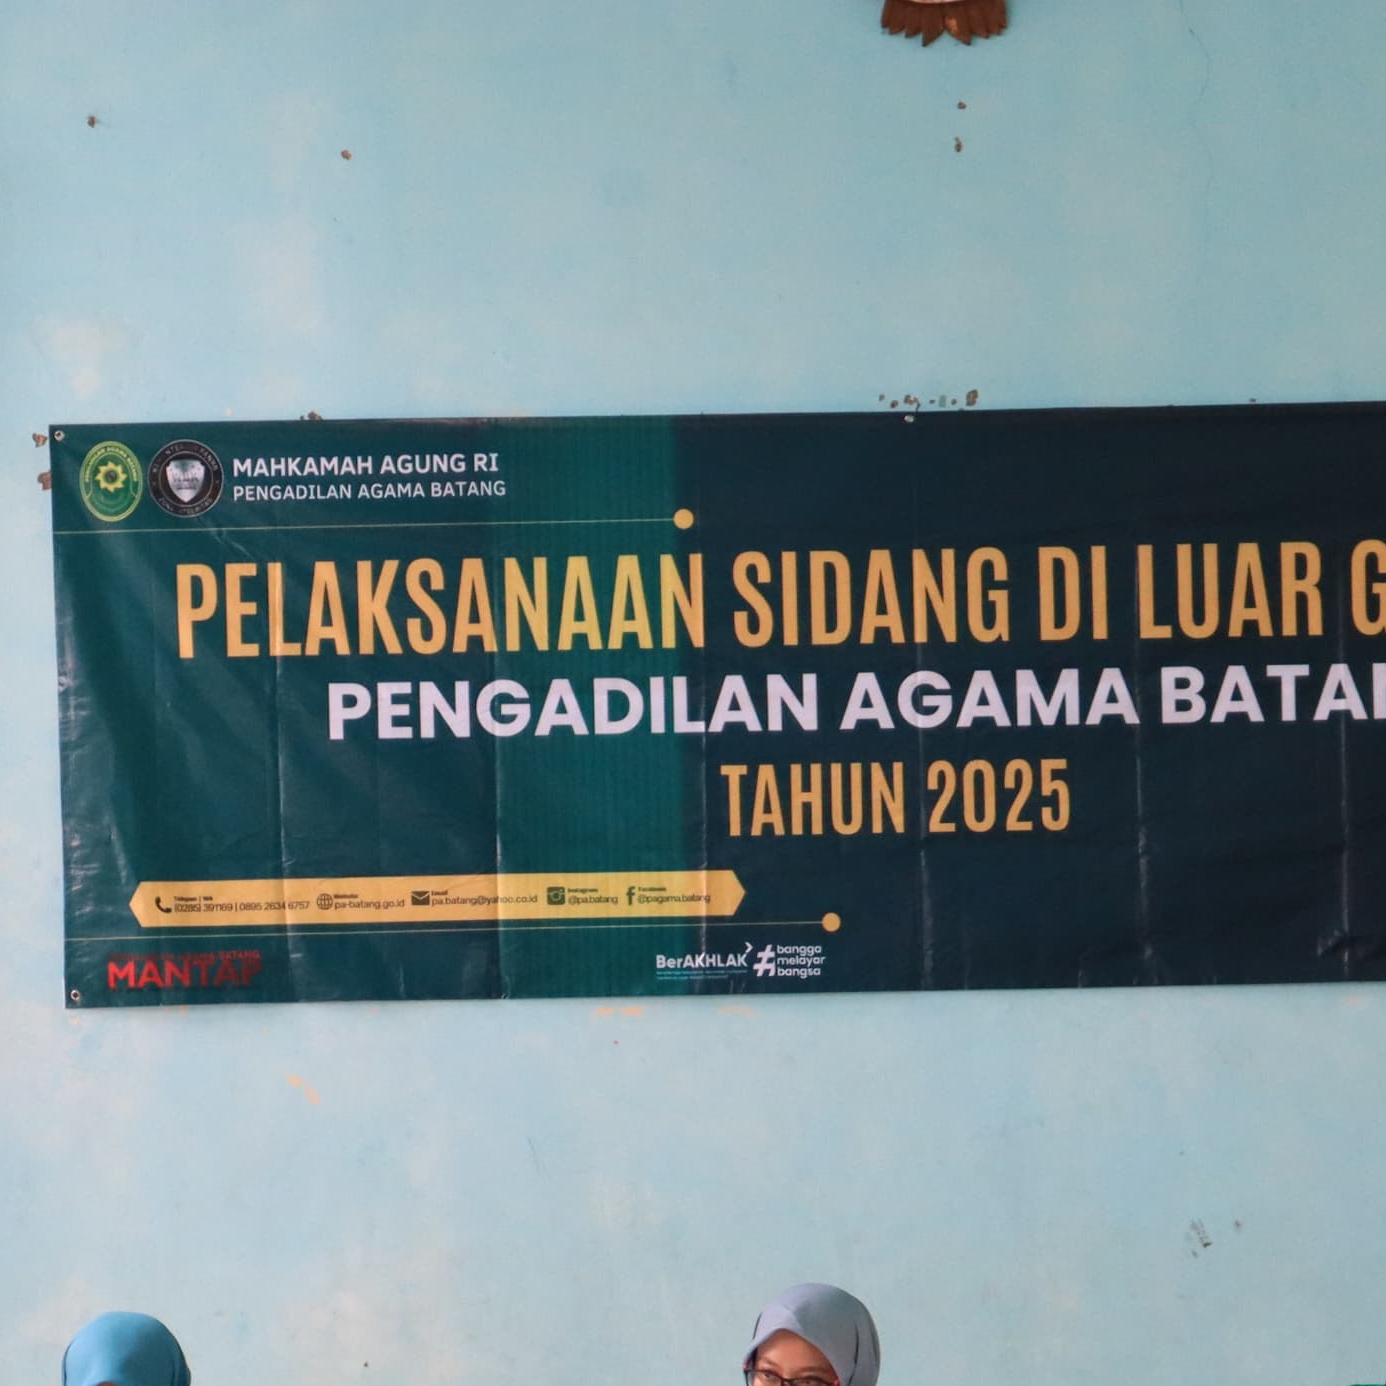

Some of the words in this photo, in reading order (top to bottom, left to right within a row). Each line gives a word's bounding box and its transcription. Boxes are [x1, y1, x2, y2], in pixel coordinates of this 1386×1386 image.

[233, 455, 373, 477] MAHKAMAH
[379, 453, 467, 475] AGUNG
[473, 453, 500, 472] RI
[233, 484, 353, 501] PENGADILAN
[357, 482, 425, 499] AGAMA
[430, 480, 507, 497] BATANG
[176, 553, 705, 659] PELAKSANAAN
[732, 547, 1009, 647] SIDANG
[1038, 546, 1108, 641] DI
[1137, 542, 1323, 639] LUAR
[327, 672, 819, 740] PENGADILAN
[840, 667, 1140, 731] AGAMA
[720, 762, 905, 837] TAHUN
[927, 758, 1070, 833] 2025
[655, 953, 748, 969] BerAKHLAK
[776, 944, 822, 957] bangga
[107, 959, 262, 989] MANTAP
[776, 966, 821, 979] bangsa
